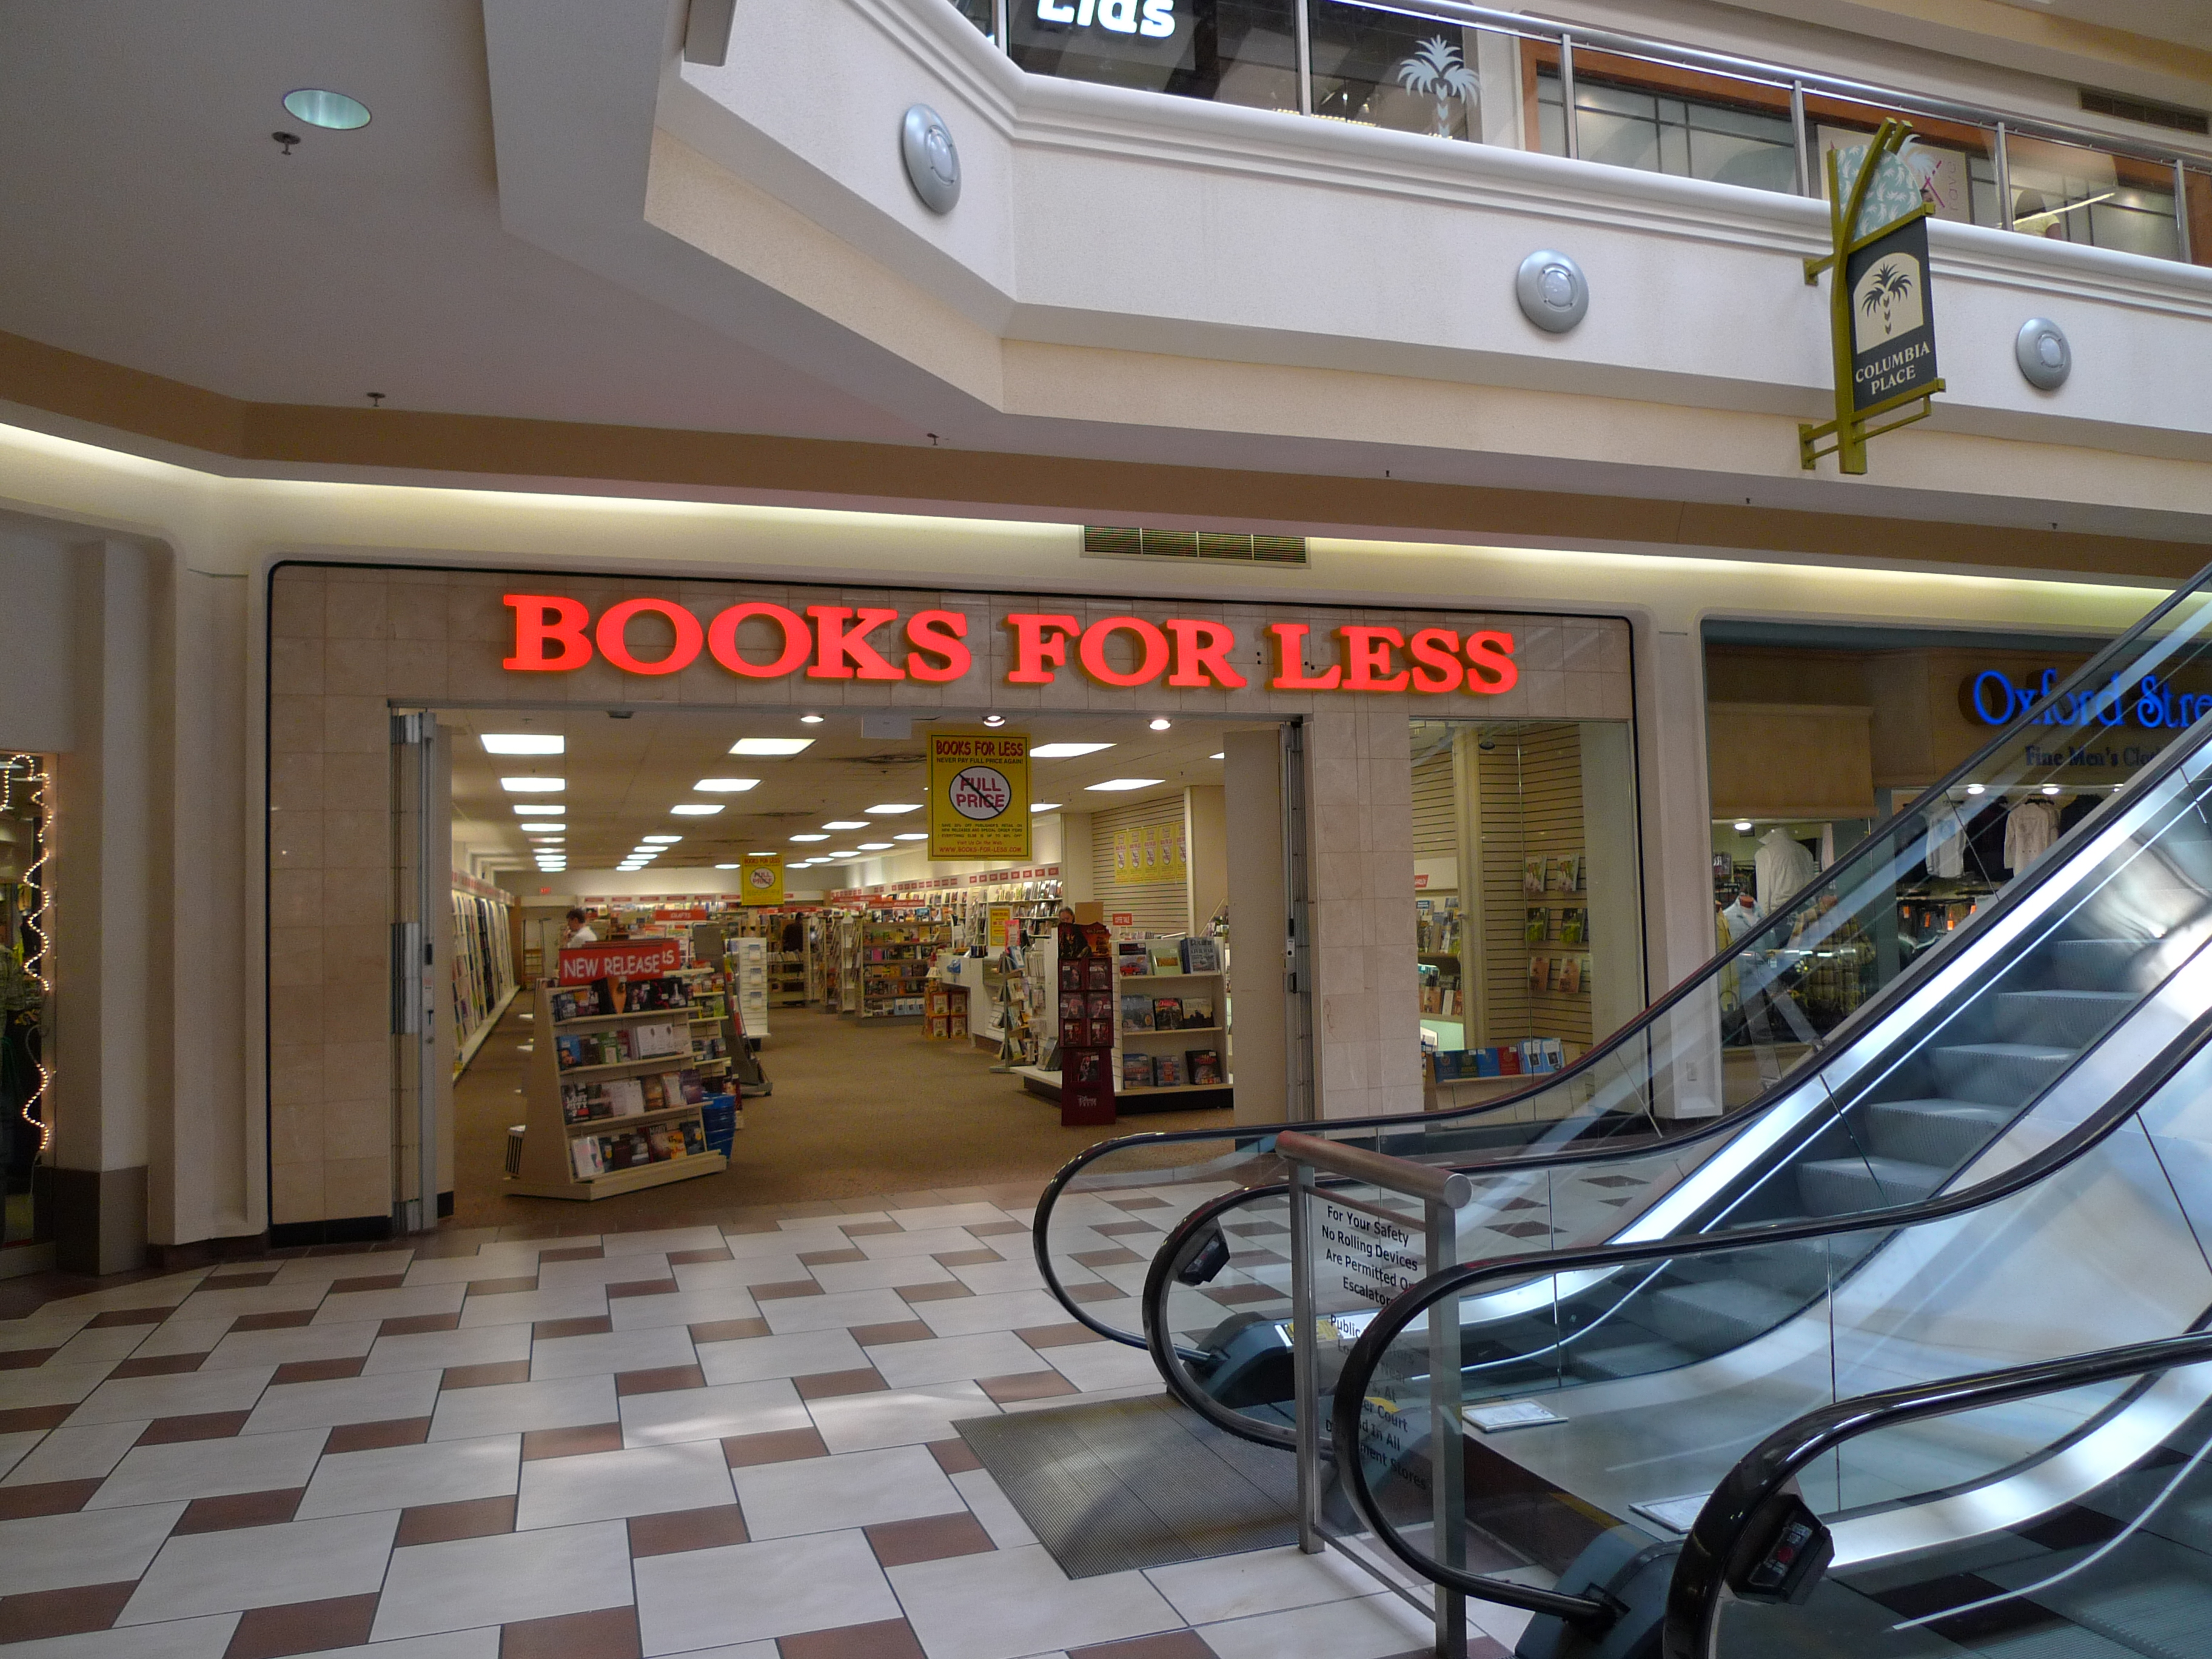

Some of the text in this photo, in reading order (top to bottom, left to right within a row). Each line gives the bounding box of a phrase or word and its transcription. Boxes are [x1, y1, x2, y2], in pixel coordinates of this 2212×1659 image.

[1855, 341, 1931, 384] COLUMBIA
[1871, 364, 1916, 395] PLACE
[503, 594, 1518, 695] BOOKS FOR LESS
[1973, 667, 2124, 726] Oxford
[936, 740, 1024, 757] BOOKS FOR LESS
[2025, 745, 2063, 766] Fine
[2068, 746, 2119, 766] Men's
[960, 777, 1002, 792] FULL
[956, 794, 1005, 808] PRICE
[563, 957, 598, 978] NEW
[1327, 1205, 1409, 1248] For Your Safety
[1322, 1225, 1418, 1272] No Rolling Devices
[1326, 1248, 1342, 1265] Are
[1345, 1255, 1396, 1285] Permitted
[1343, 1276, 1395, 1306] Escalator
[1330, 1314, 1361, 1339] Public
[1378, 1405, 1408, 1433] Court
[1371, 1424, 1383, 1441] In
[1386, 1433, 1401, 1451] All
[1391, 1457, 1427, 1490] Stores
